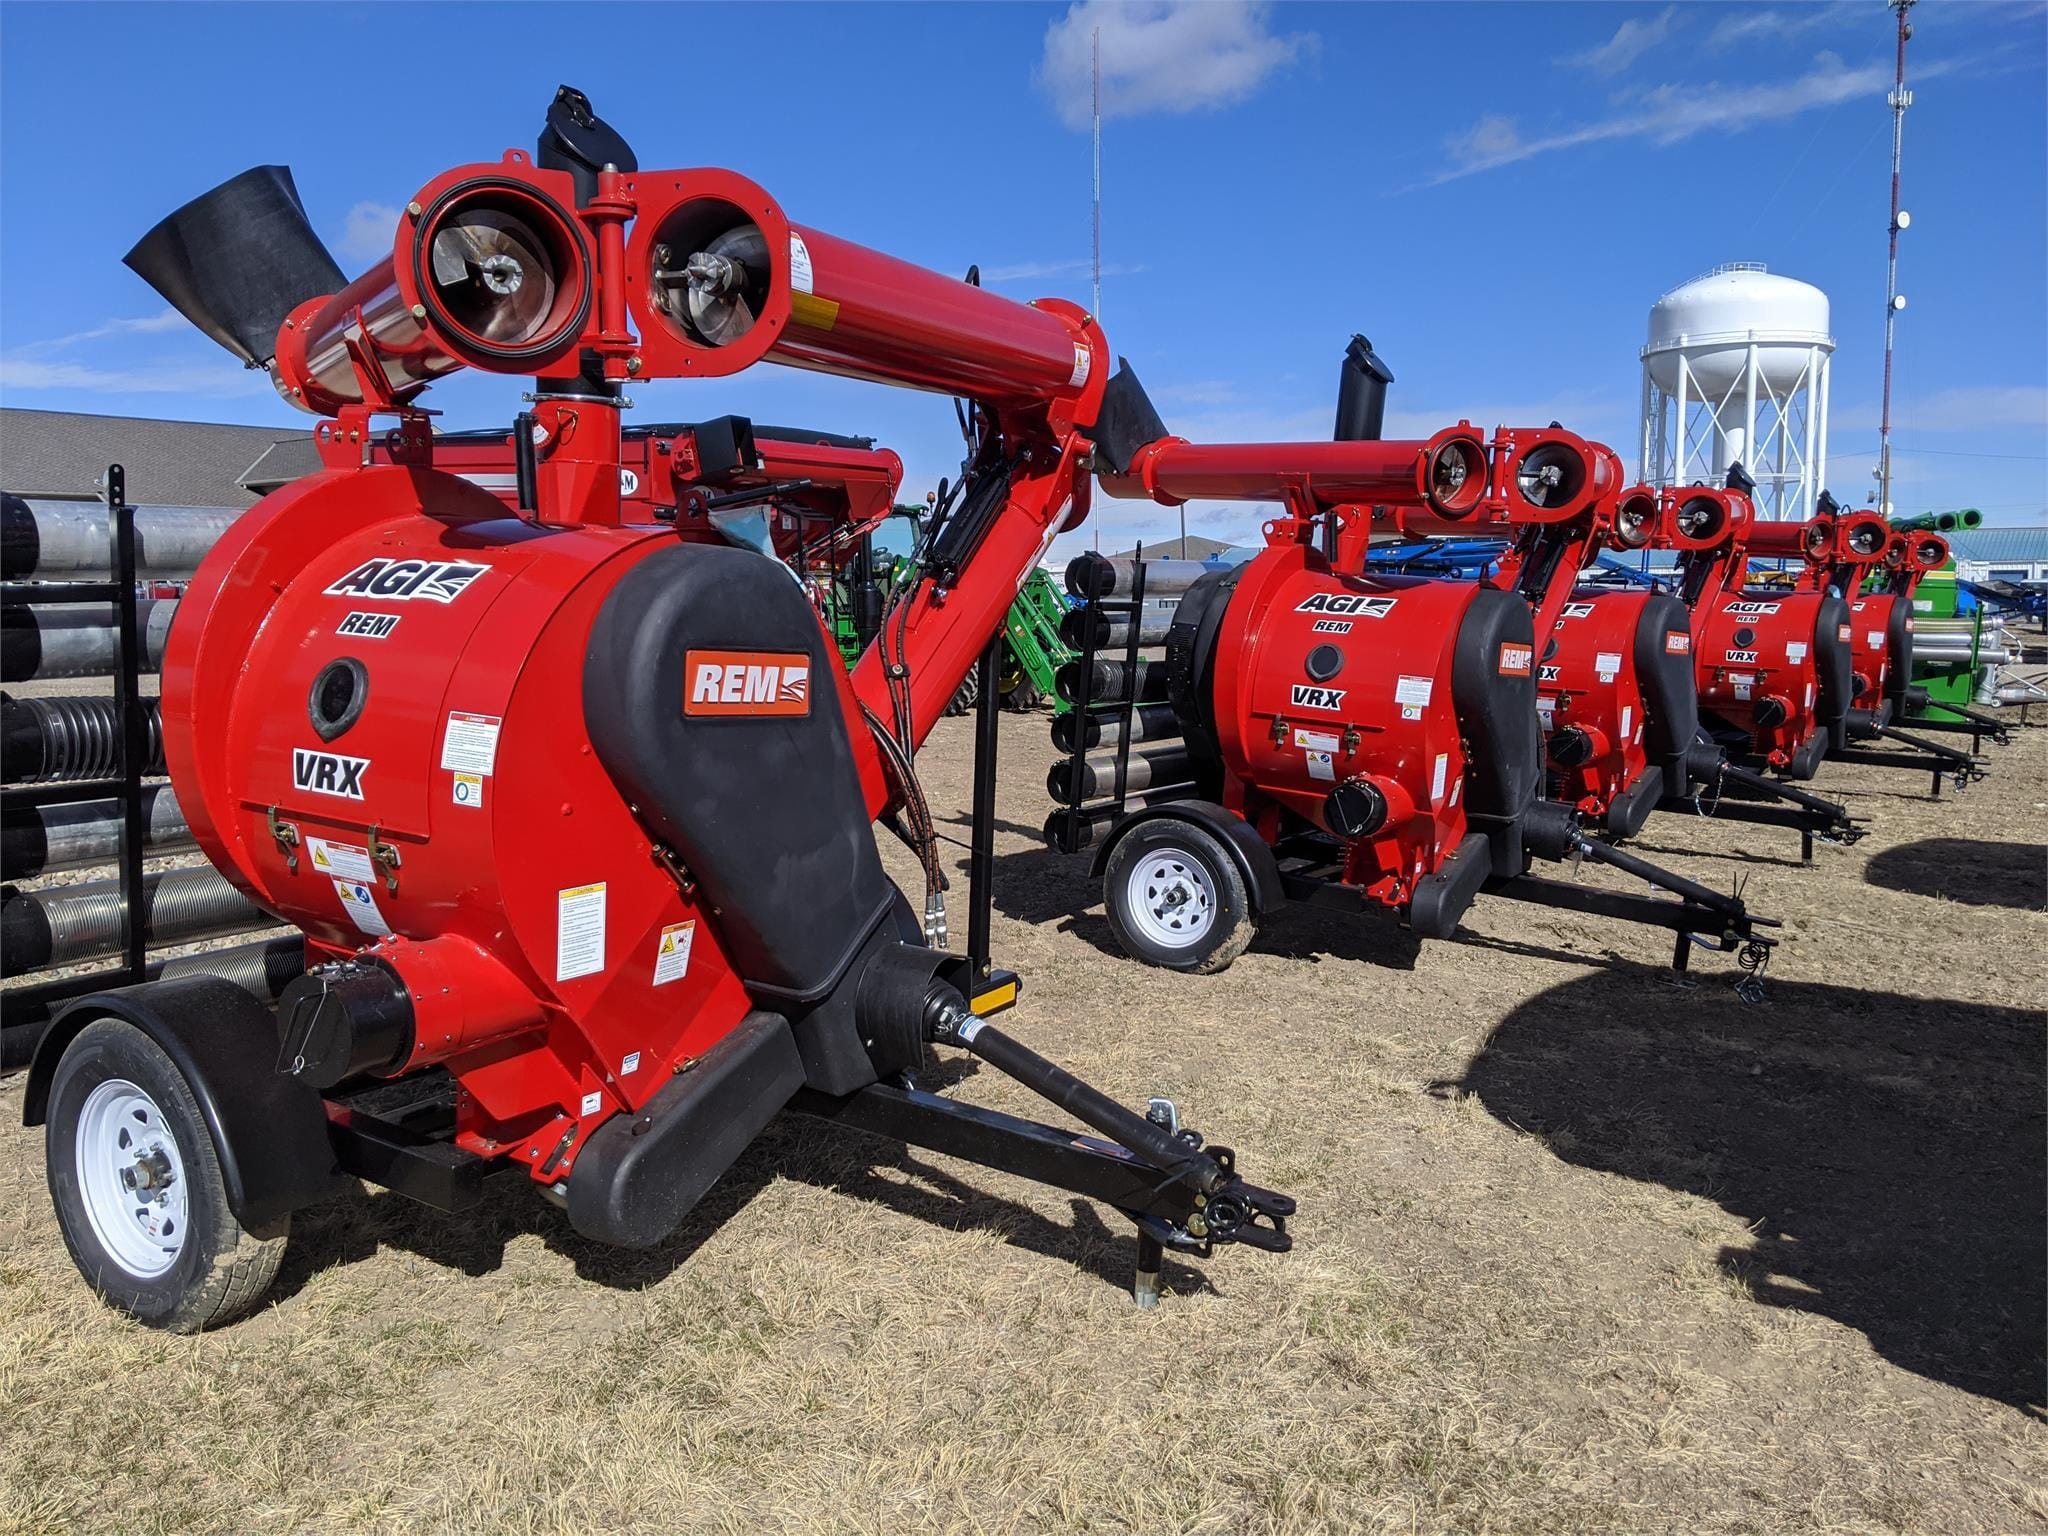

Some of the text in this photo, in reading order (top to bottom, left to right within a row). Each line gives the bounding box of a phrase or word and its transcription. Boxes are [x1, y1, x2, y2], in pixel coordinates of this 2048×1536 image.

[331, 561, 443, 596] AGI
[1299, 594, 1363, 613] AGI
[1726, 603, 1761, 612] AGI
[339, 614, 398, 636] REM
[1314, 621, 1351, 633] REM
[1502, 648, 1524, 669] REM
[1726, 651, 1756, 662] VRX
[691, 663, 781, 704] REM
[1293, 686, 1343, 709] VRX
[295, 752, 365, 796] VRX
